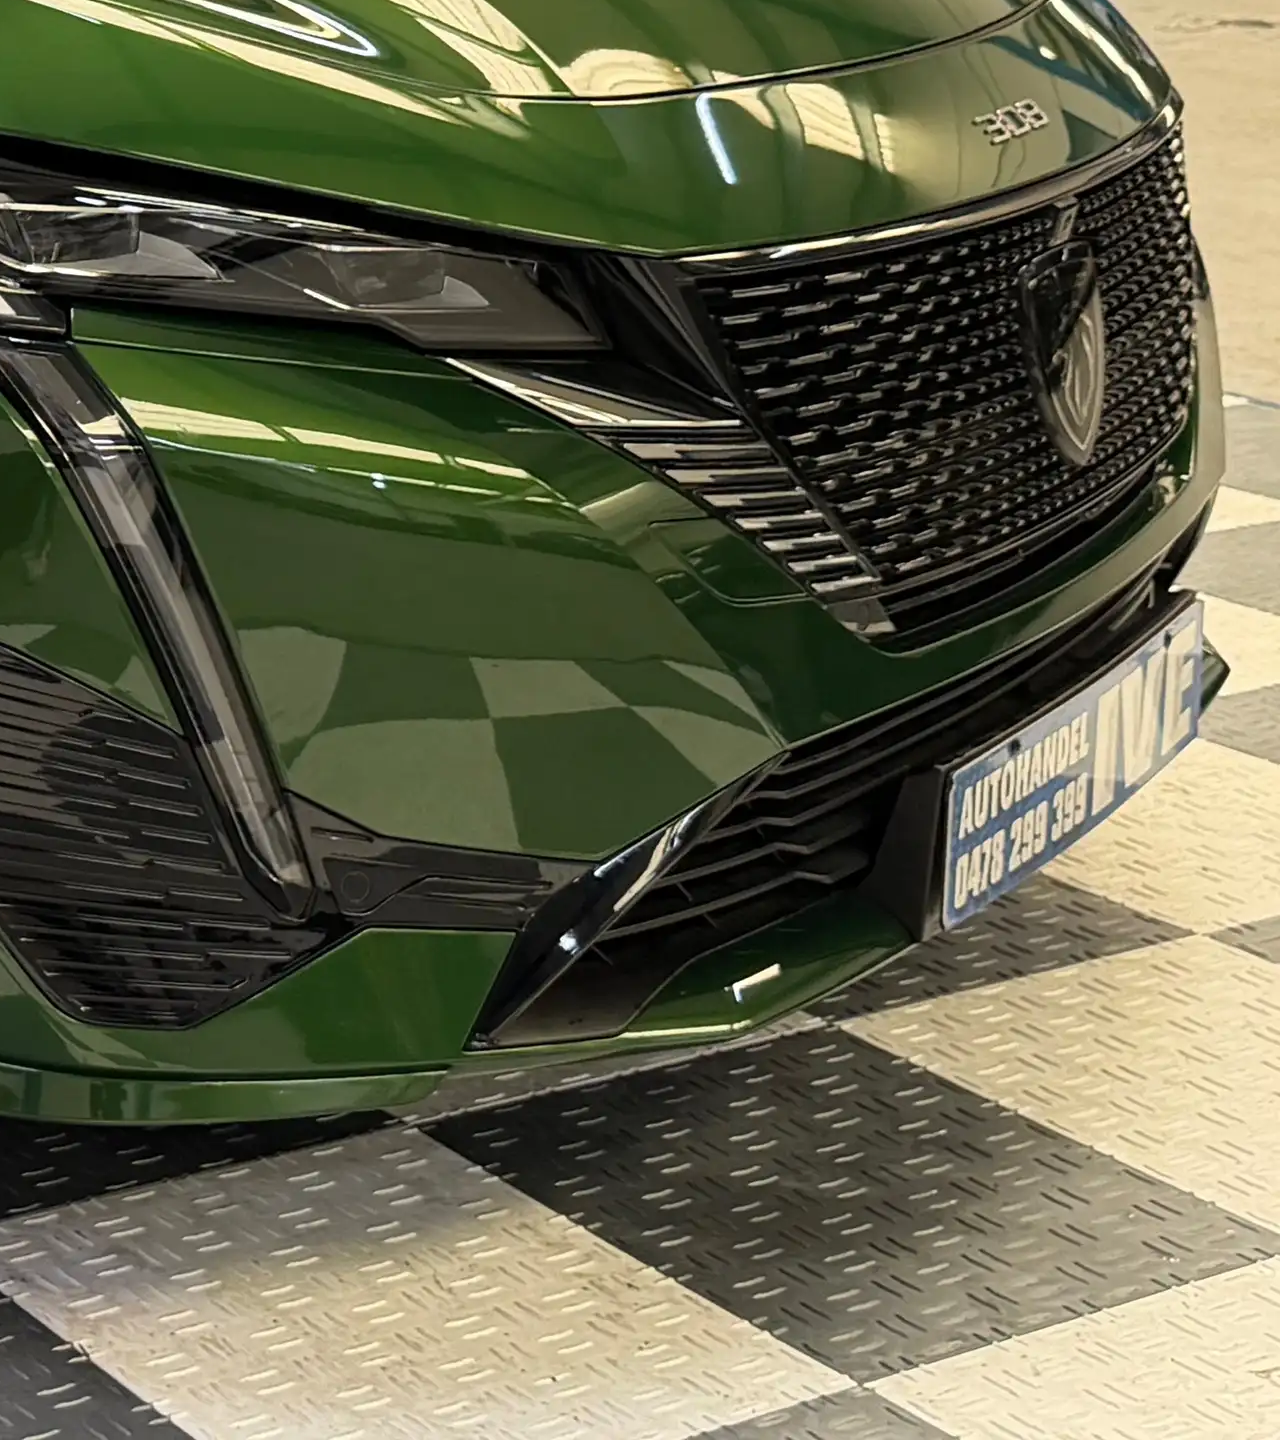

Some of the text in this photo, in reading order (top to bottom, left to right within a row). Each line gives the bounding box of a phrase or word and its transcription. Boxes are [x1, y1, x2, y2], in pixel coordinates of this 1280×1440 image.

[972, 99, 1049, 145] 308
[959, 712, 1089, 840] AUTOHANDEL
[954, 772, 1089, 910] 0478 299 399
